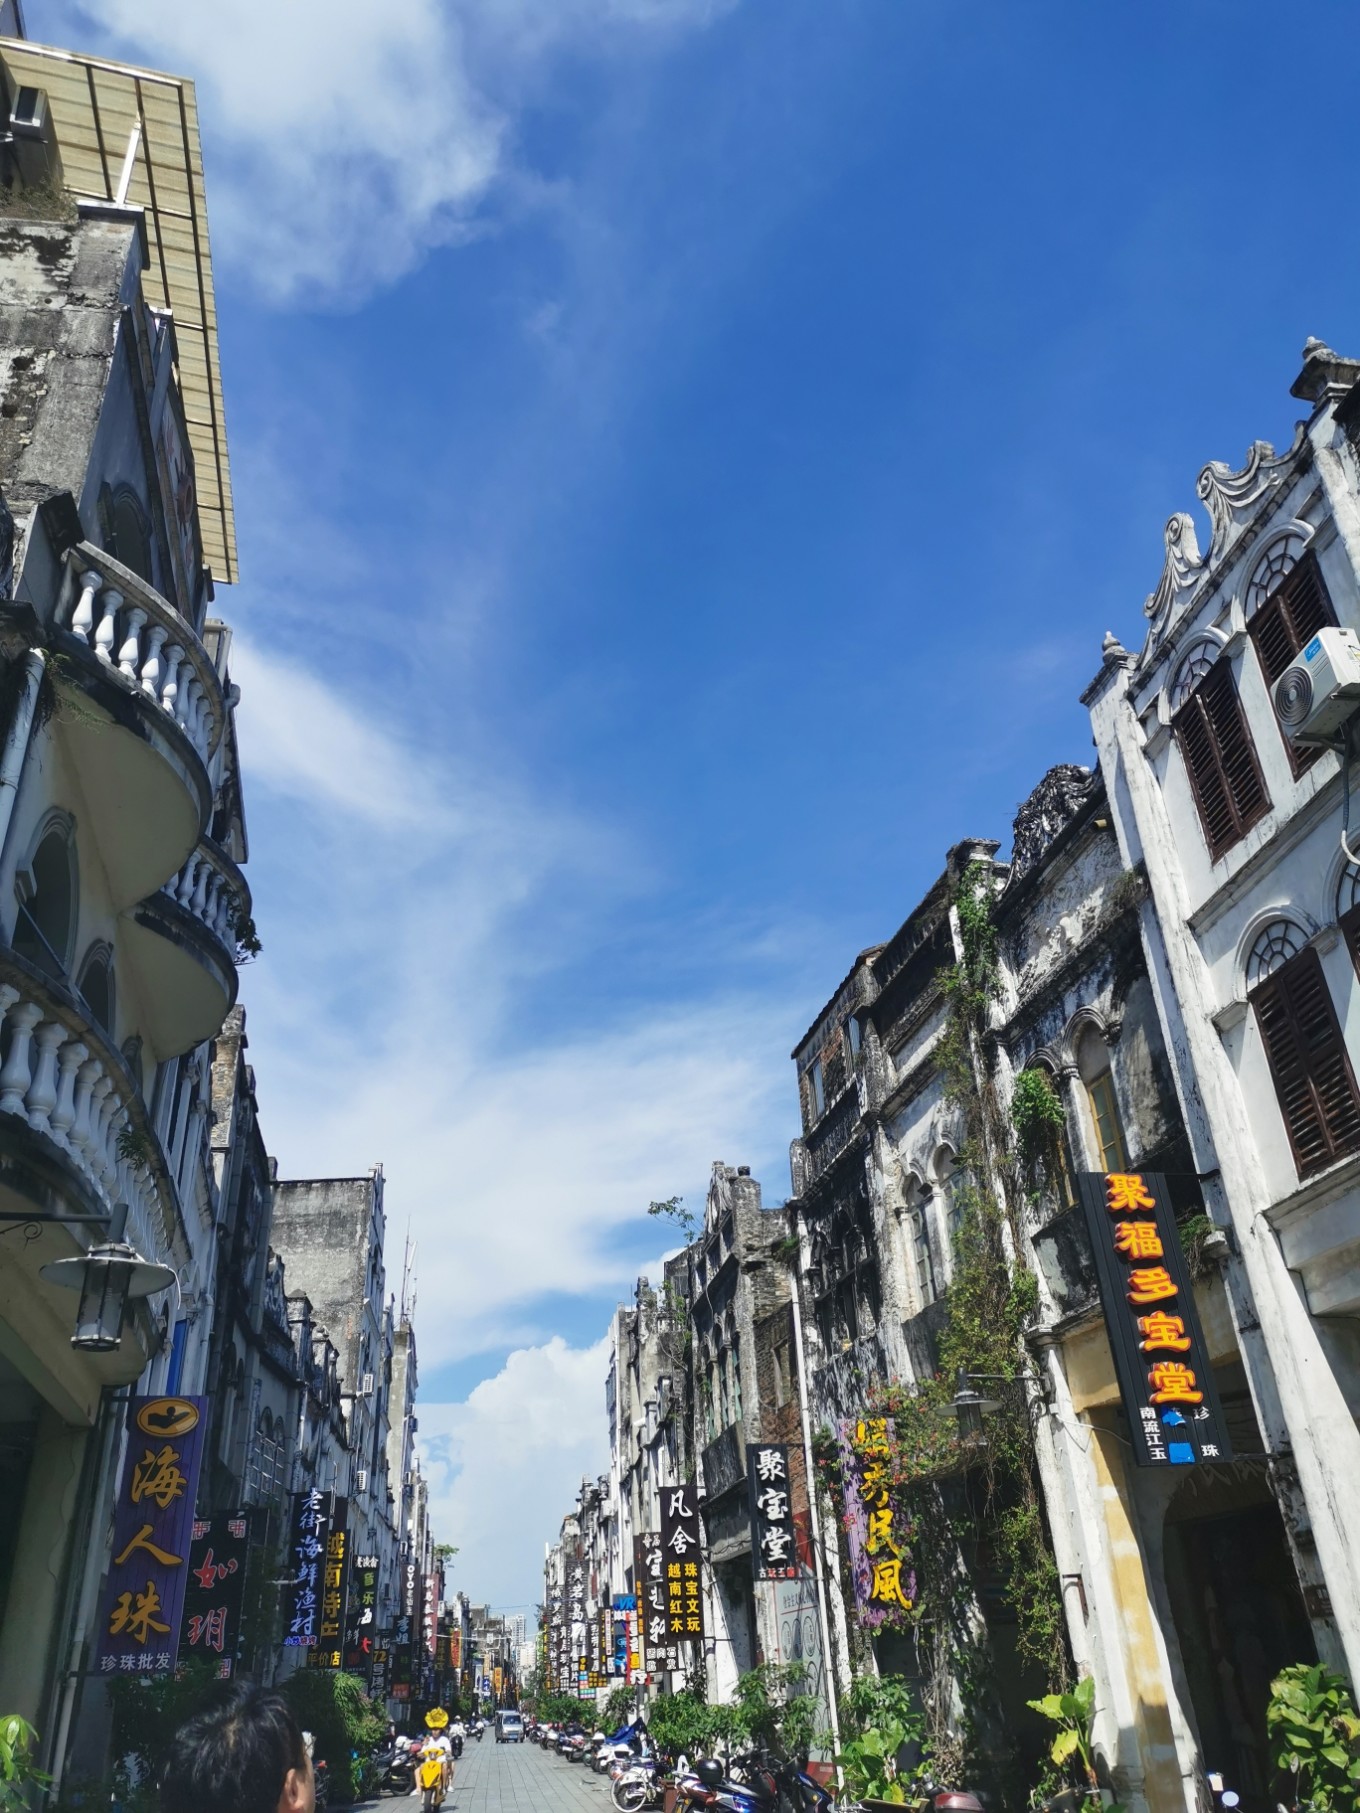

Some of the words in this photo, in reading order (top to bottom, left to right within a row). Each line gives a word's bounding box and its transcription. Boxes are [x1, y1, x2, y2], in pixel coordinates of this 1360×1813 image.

[1105, 1173, 1203, 1406] 聚福多宝堂
[668, 1488, 696, 1555] 凡舍
[756, 1449, 792, 1562] 聚宝堂
[108, 1444, 187, 1644] 海人珠
[289, 1486, 327, 1636] 老街海鲜渔村
[620, 1597, 635, 1610] VR
[667, 1562, 684, 1633] 越南红木
[684, 1562, 701, 1633] 珠宝文玩
[100, 1651, 171, 1672] 珍珠批发
